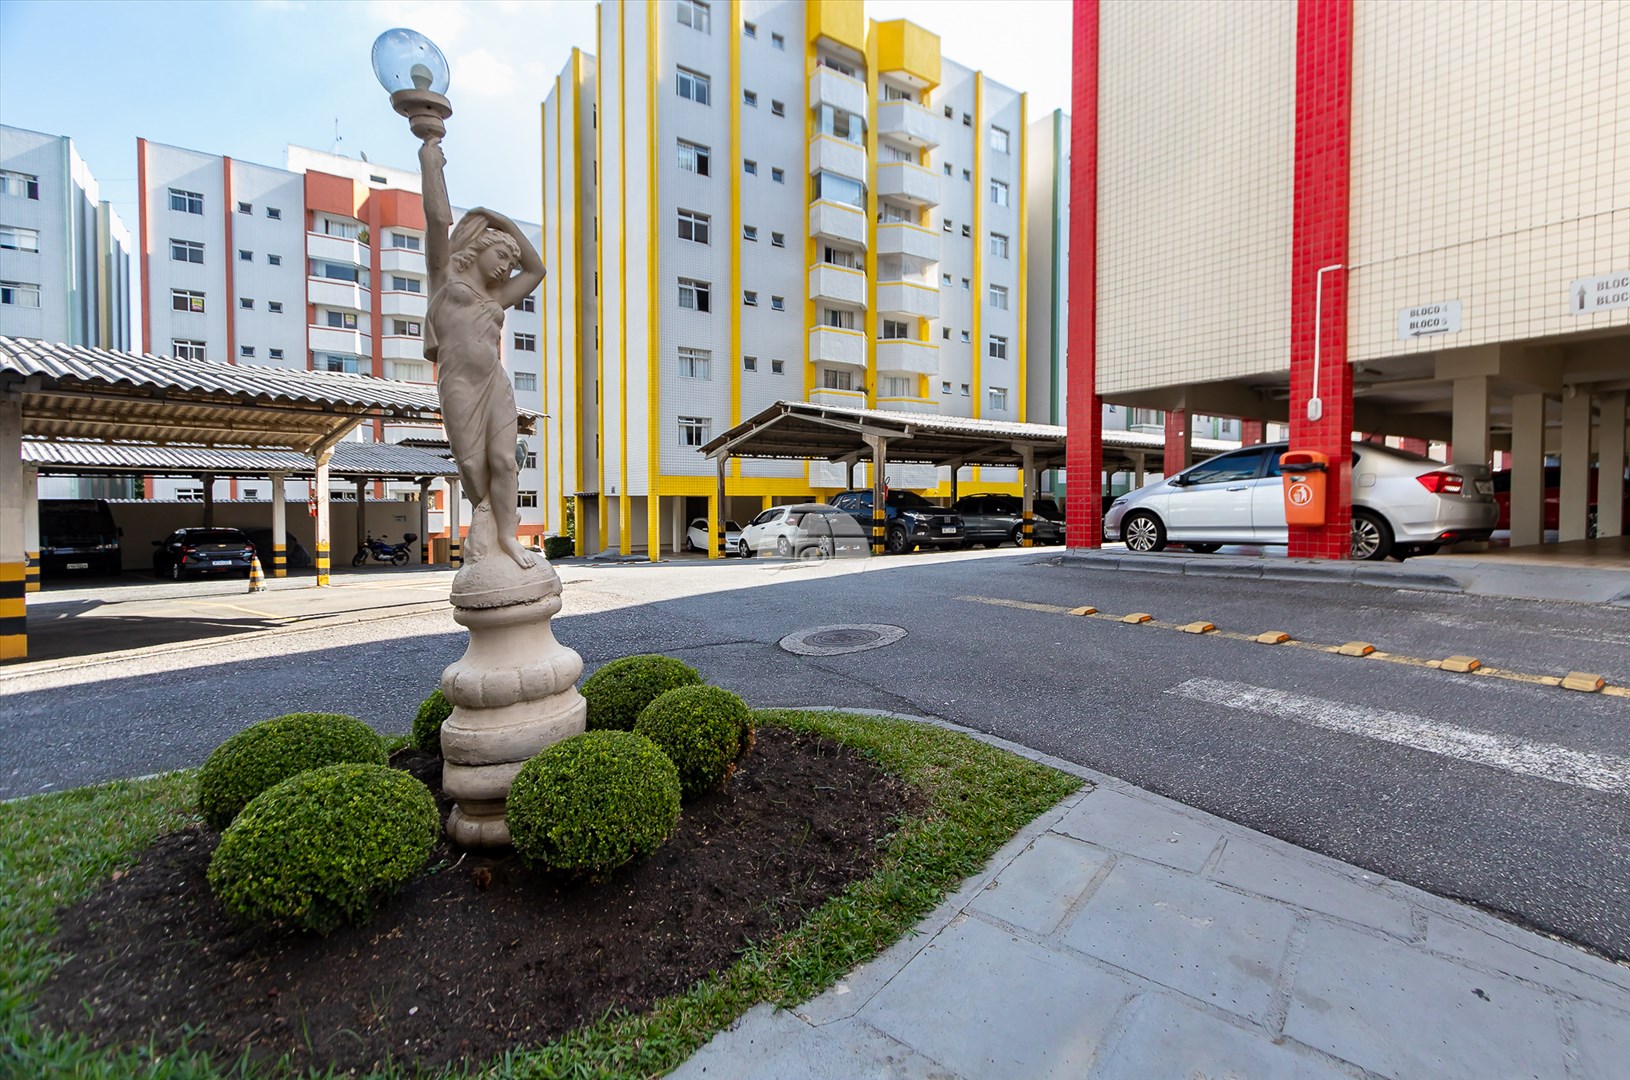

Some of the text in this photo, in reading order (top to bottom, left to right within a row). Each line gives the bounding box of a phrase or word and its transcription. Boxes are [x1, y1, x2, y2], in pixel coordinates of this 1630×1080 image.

[1597, 277, 1630, 292] BLOC
[1596, 292, 1630, 306] BLOC
[1410, 305, 1440, 317] BLOCO
[1409, 318, 1440, 330] BLOCO
